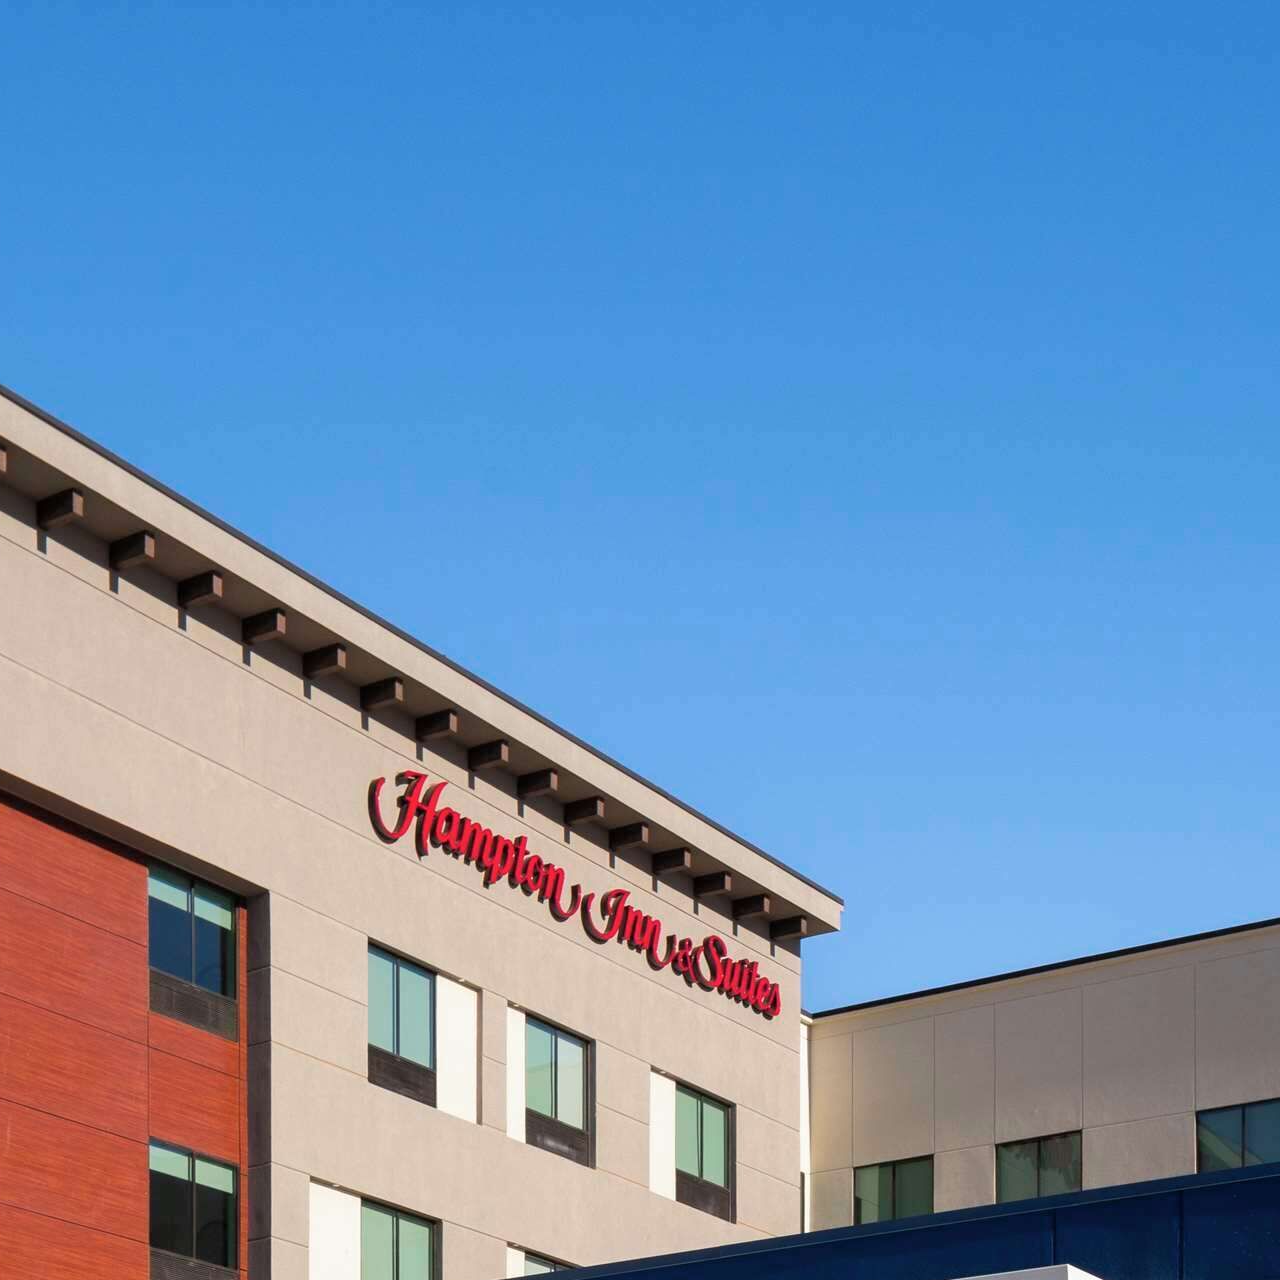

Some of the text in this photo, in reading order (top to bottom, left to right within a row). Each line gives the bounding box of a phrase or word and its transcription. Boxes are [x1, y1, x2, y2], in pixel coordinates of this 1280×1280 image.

[368, 770, 581, 922] Hampton
[581, 888, 677, 971] Inn
[691, 935, 781, 1020] Suites
